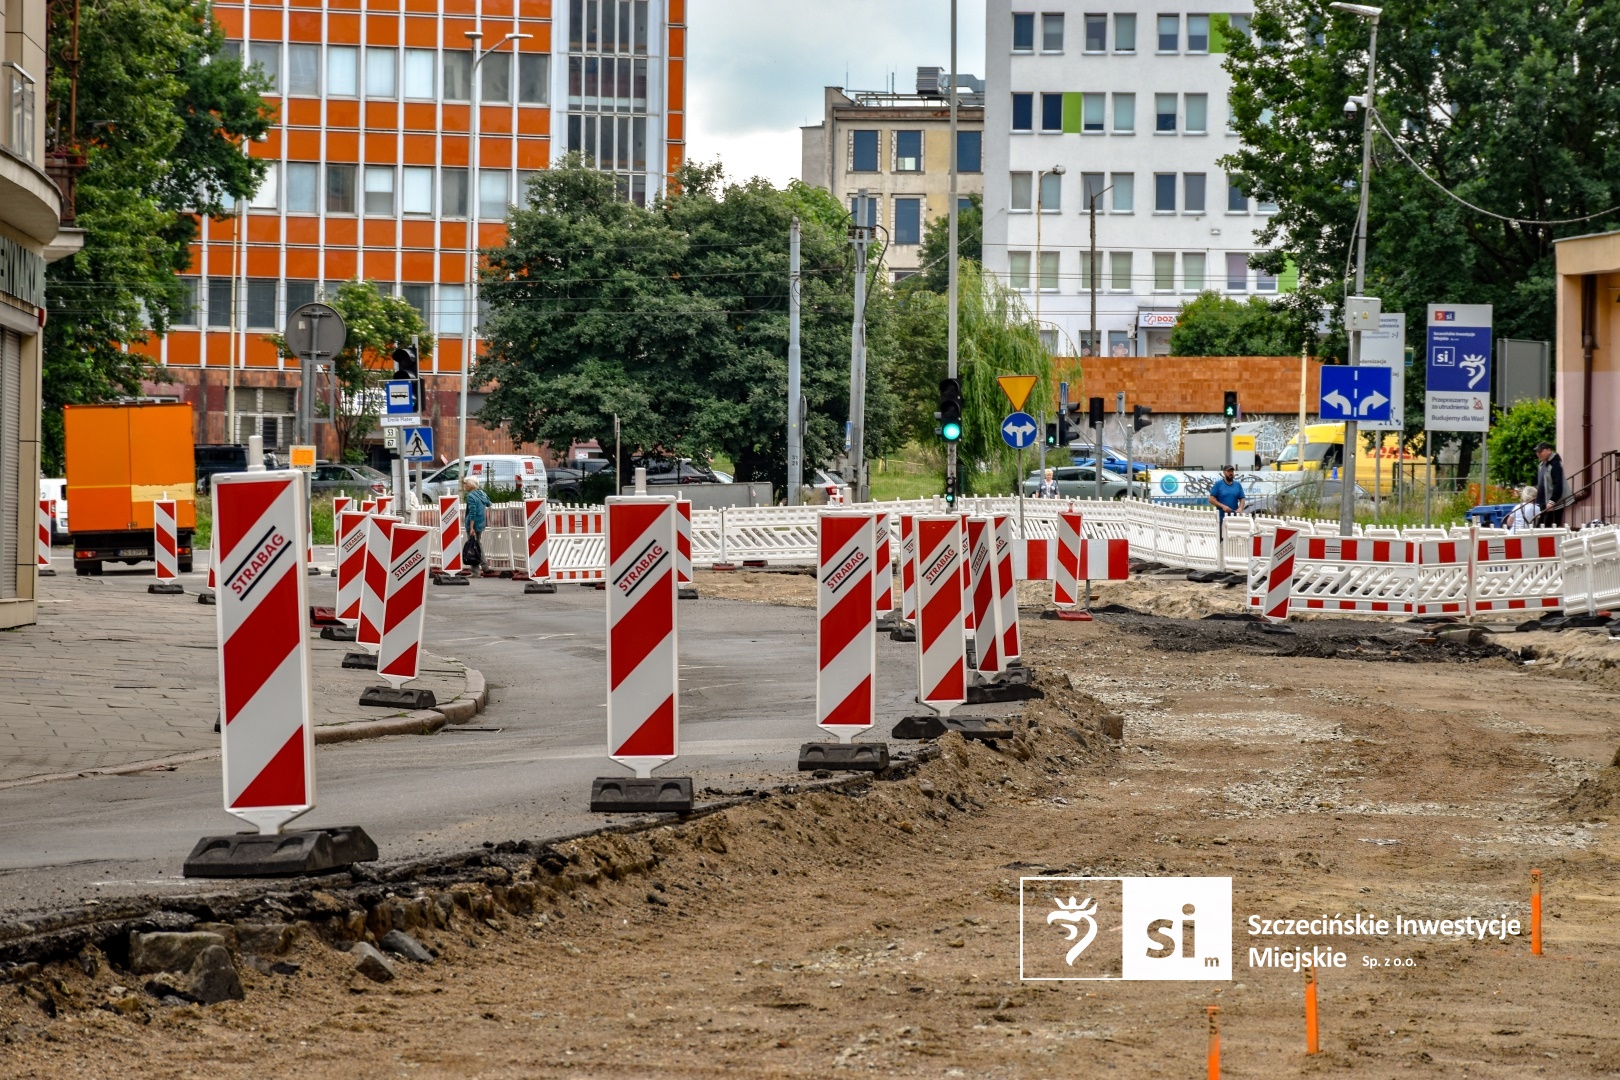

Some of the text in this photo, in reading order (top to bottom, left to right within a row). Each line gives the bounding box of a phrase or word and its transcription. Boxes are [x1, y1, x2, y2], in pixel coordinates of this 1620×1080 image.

[1437, 350, 1448, 363] si
[1431, 414, 1460, 422] Budujemy
[344, 532, 364, 551] STRABAG
[231, 533, 285, 594] STRABAG
[394, 553, 422, 578] STRABAG
[619, 545, 663, 592] STRABAG
[827, 551, 865, 589] STRABAG
[925, 548, 955, 582] STRABAG
